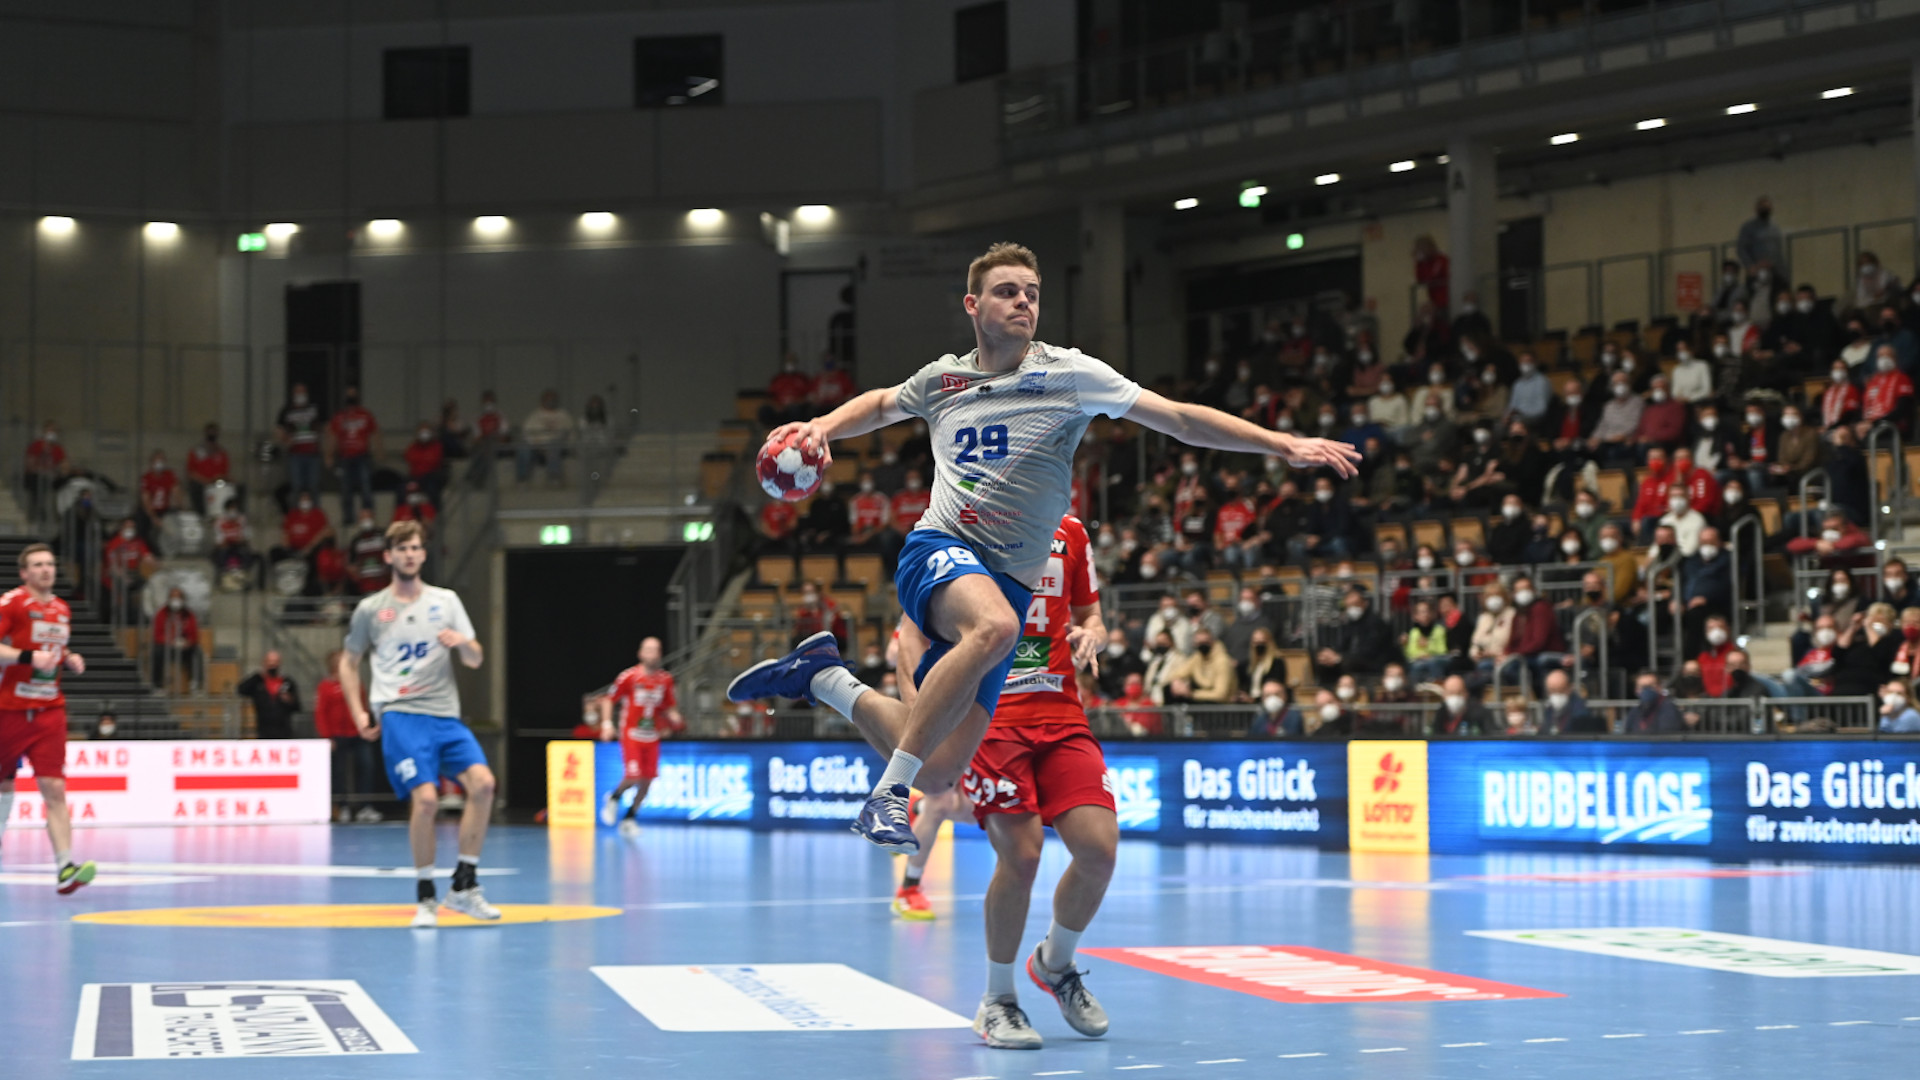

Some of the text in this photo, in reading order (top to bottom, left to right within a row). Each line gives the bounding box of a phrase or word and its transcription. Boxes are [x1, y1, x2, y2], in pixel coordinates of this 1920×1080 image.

[955, 424, 1009, 465] 29
[926, 546, 980, 580] 29
[1037, 576, 1056, 588] TE
[398, 642, 429, 662] 26
[172, 747, 302, 767] EMSLAND
[768, 757, 807, 793] Das
[1183, 757, 1318, 801] Das Glück
[1746, 761, 1811, 809] Das
[981, 776, 1018, 803] 94
[1482, 770, 1703, 829] RUBBELLOSE
[174, 799, 270, 818] ARENA
[1363, 802, 1416, 824] LOTTO
[1746, 814, 1778, 842] für
